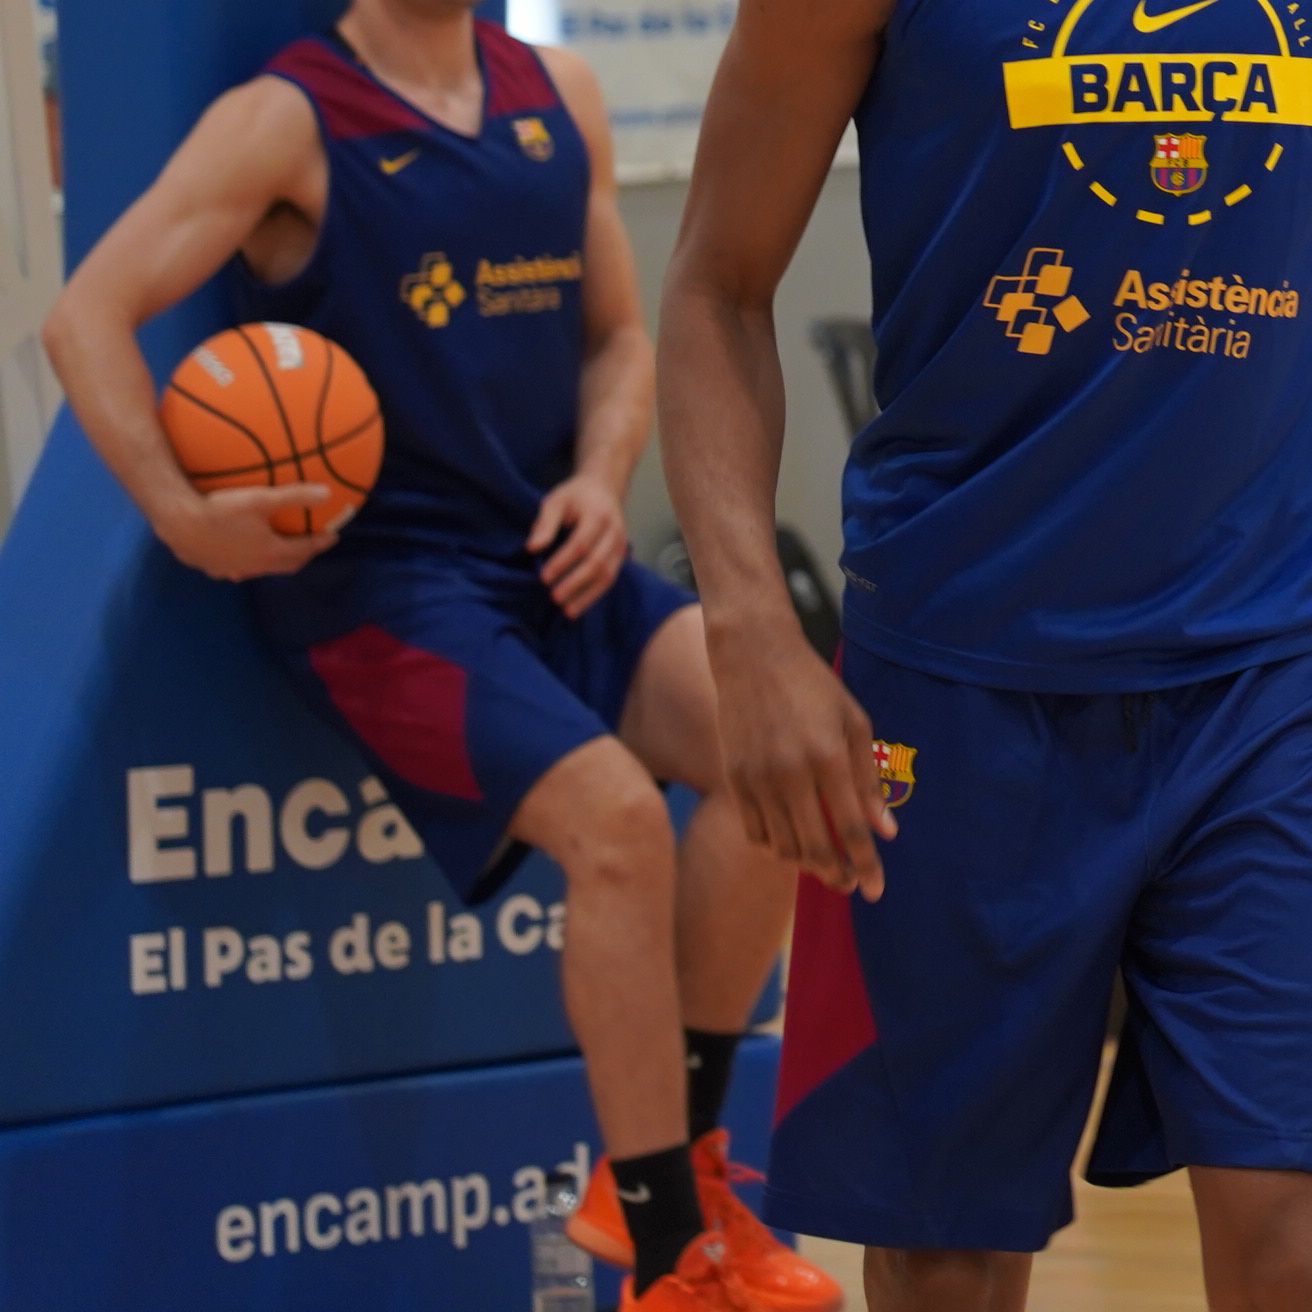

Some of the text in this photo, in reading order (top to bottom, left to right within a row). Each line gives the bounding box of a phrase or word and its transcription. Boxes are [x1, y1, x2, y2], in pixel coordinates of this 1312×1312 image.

[1021, 19, 1046, 50] FC
[1068, 61, 1278, 121] BARÇA
[127, 764, 425, 884] Enca
[130, 894, 568, 995] El Pas de la Ca
